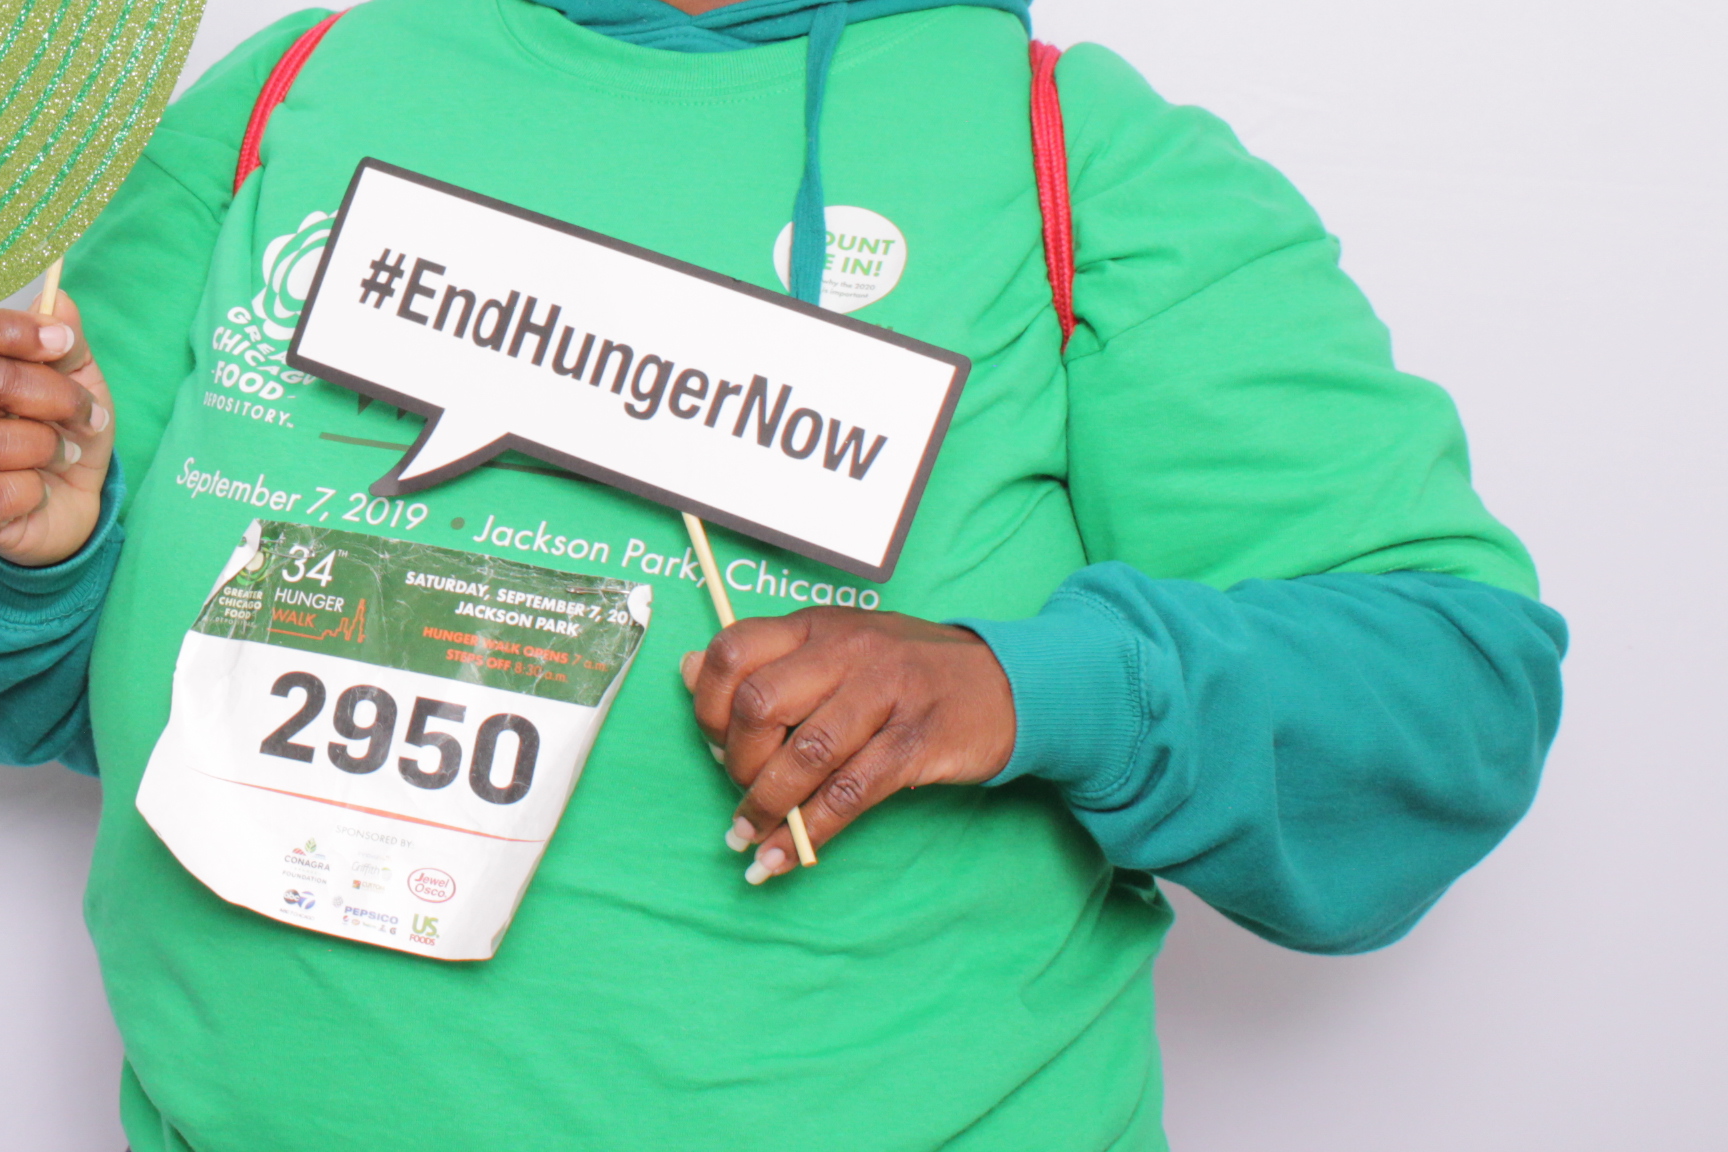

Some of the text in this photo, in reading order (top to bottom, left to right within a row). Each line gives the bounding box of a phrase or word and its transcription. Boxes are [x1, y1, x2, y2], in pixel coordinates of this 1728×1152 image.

[825, 231, 895, 255] UNT
[841, 257, 883, 277] IN!
[830, 289, 869, 299] important
[840, 280, 852, 289] the
[855, 283, 875, 291] 2020
[227, 306, 287, 364] GREA
[358, 248, 888, 481] #EndHungerNow
[214, 360, 284, 400] FOOD
[176, 457, 302, 512] September
[306, 486, 337, 522] 7,
[342, 492, 428, 531] 2019
[473, 515, 610, 564] Jackson
[218, 596, 262, 610] CHICAGO
[223, 586, 263, 600] GREATER
[274, 587, 345, 613] HUNGER
[405, 570, 491, 600] SATURDAY,
[496, 588, 585, 616] SEPTEMBER
[587, 605, 603, 623] 7,
[224, 607, 251, 620] FOOD
[272, 606, 319, 629] WALK
[455, 601, 581, 637] JACKSON PARK
[423, 626, 609, 672] HUNGER WALK OPENS 7 a.m.
[446, 649, 569, 683] STEPS OFF 8:30 a.m.
[259, 670, 541, 806] 2950
[336, 824, 398, 846] SPONSORED
[284, 854, 331, 872] CONAGRA
[351, 861, 381, 877] Griffith
[282, 869, 328, 885] FOUNDATION
[414, 872, 450, 888] Jewel
[344, 905, 399, 925] PEPSICO
[409, 933, 436, 946] FOODS
